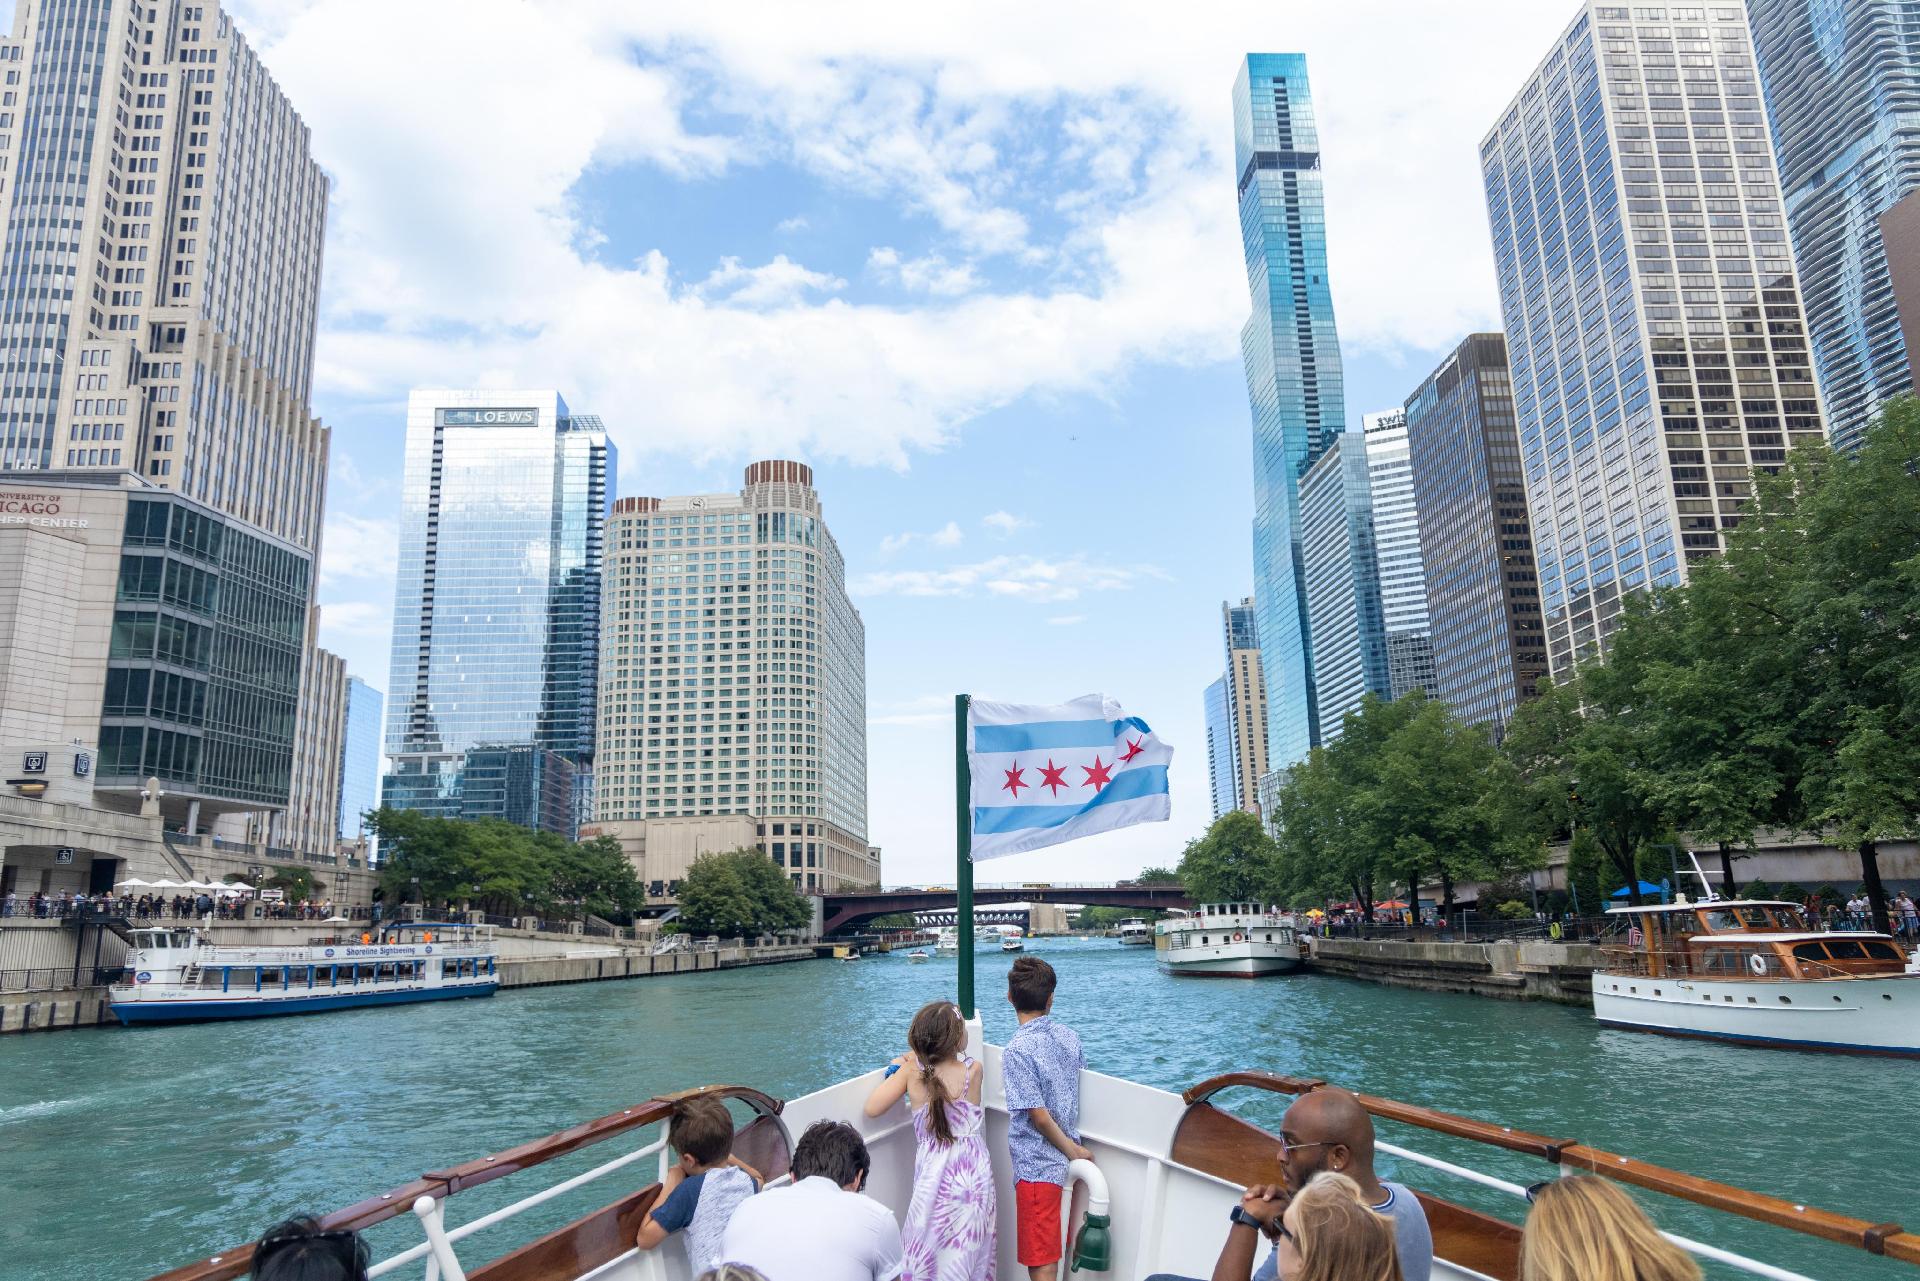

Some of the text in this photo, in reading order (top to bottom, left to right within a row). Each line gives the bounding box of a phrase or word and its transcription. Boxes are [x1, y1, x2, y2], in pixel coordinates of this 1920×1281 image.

[475, 411, 533, 423] LOEWS
[30, 517, 89, 529] CENTER
[346, 947, 378, 956] Shoreline
[379, 946, 416, 956] Sightseeing
